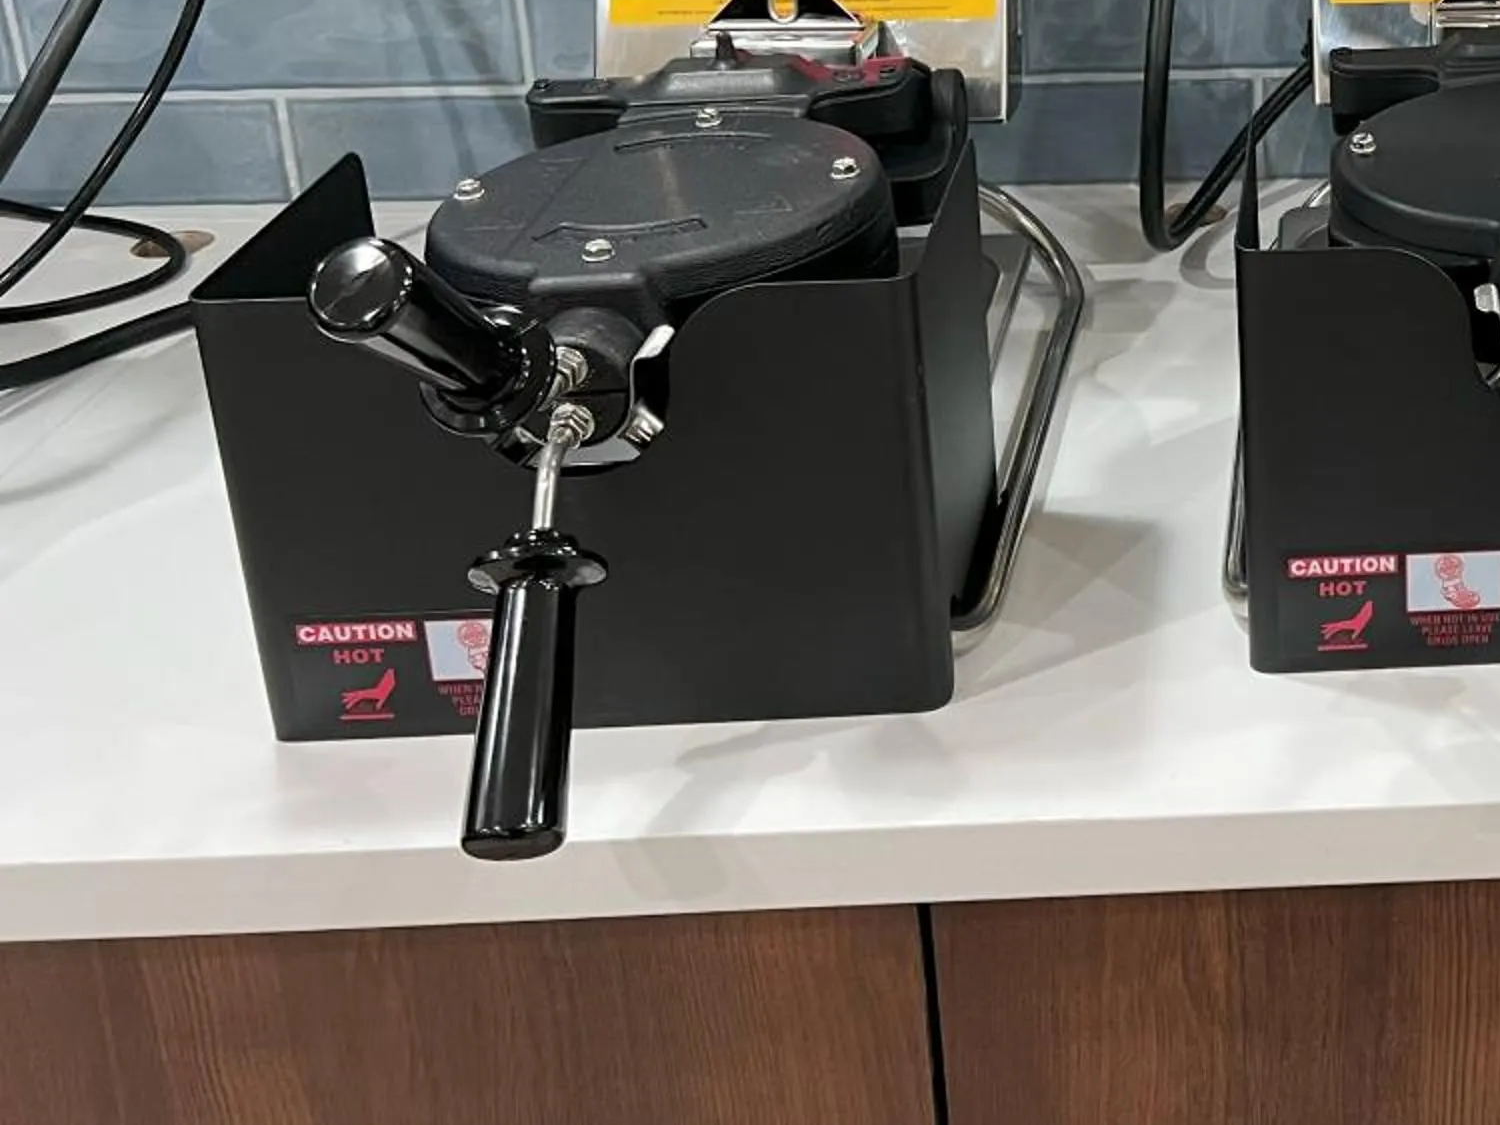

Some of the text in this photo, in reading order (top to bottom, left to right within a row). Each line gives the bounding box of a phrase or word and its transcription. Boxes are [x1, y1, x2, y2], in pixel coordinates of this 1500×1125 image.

[1291, 556, 1396, 575] CAUTION
[1319, 580, 1368, 597] HOT
[299, 622, 415, 642] CAUTION
[333, 648, 385, 665] HOT
